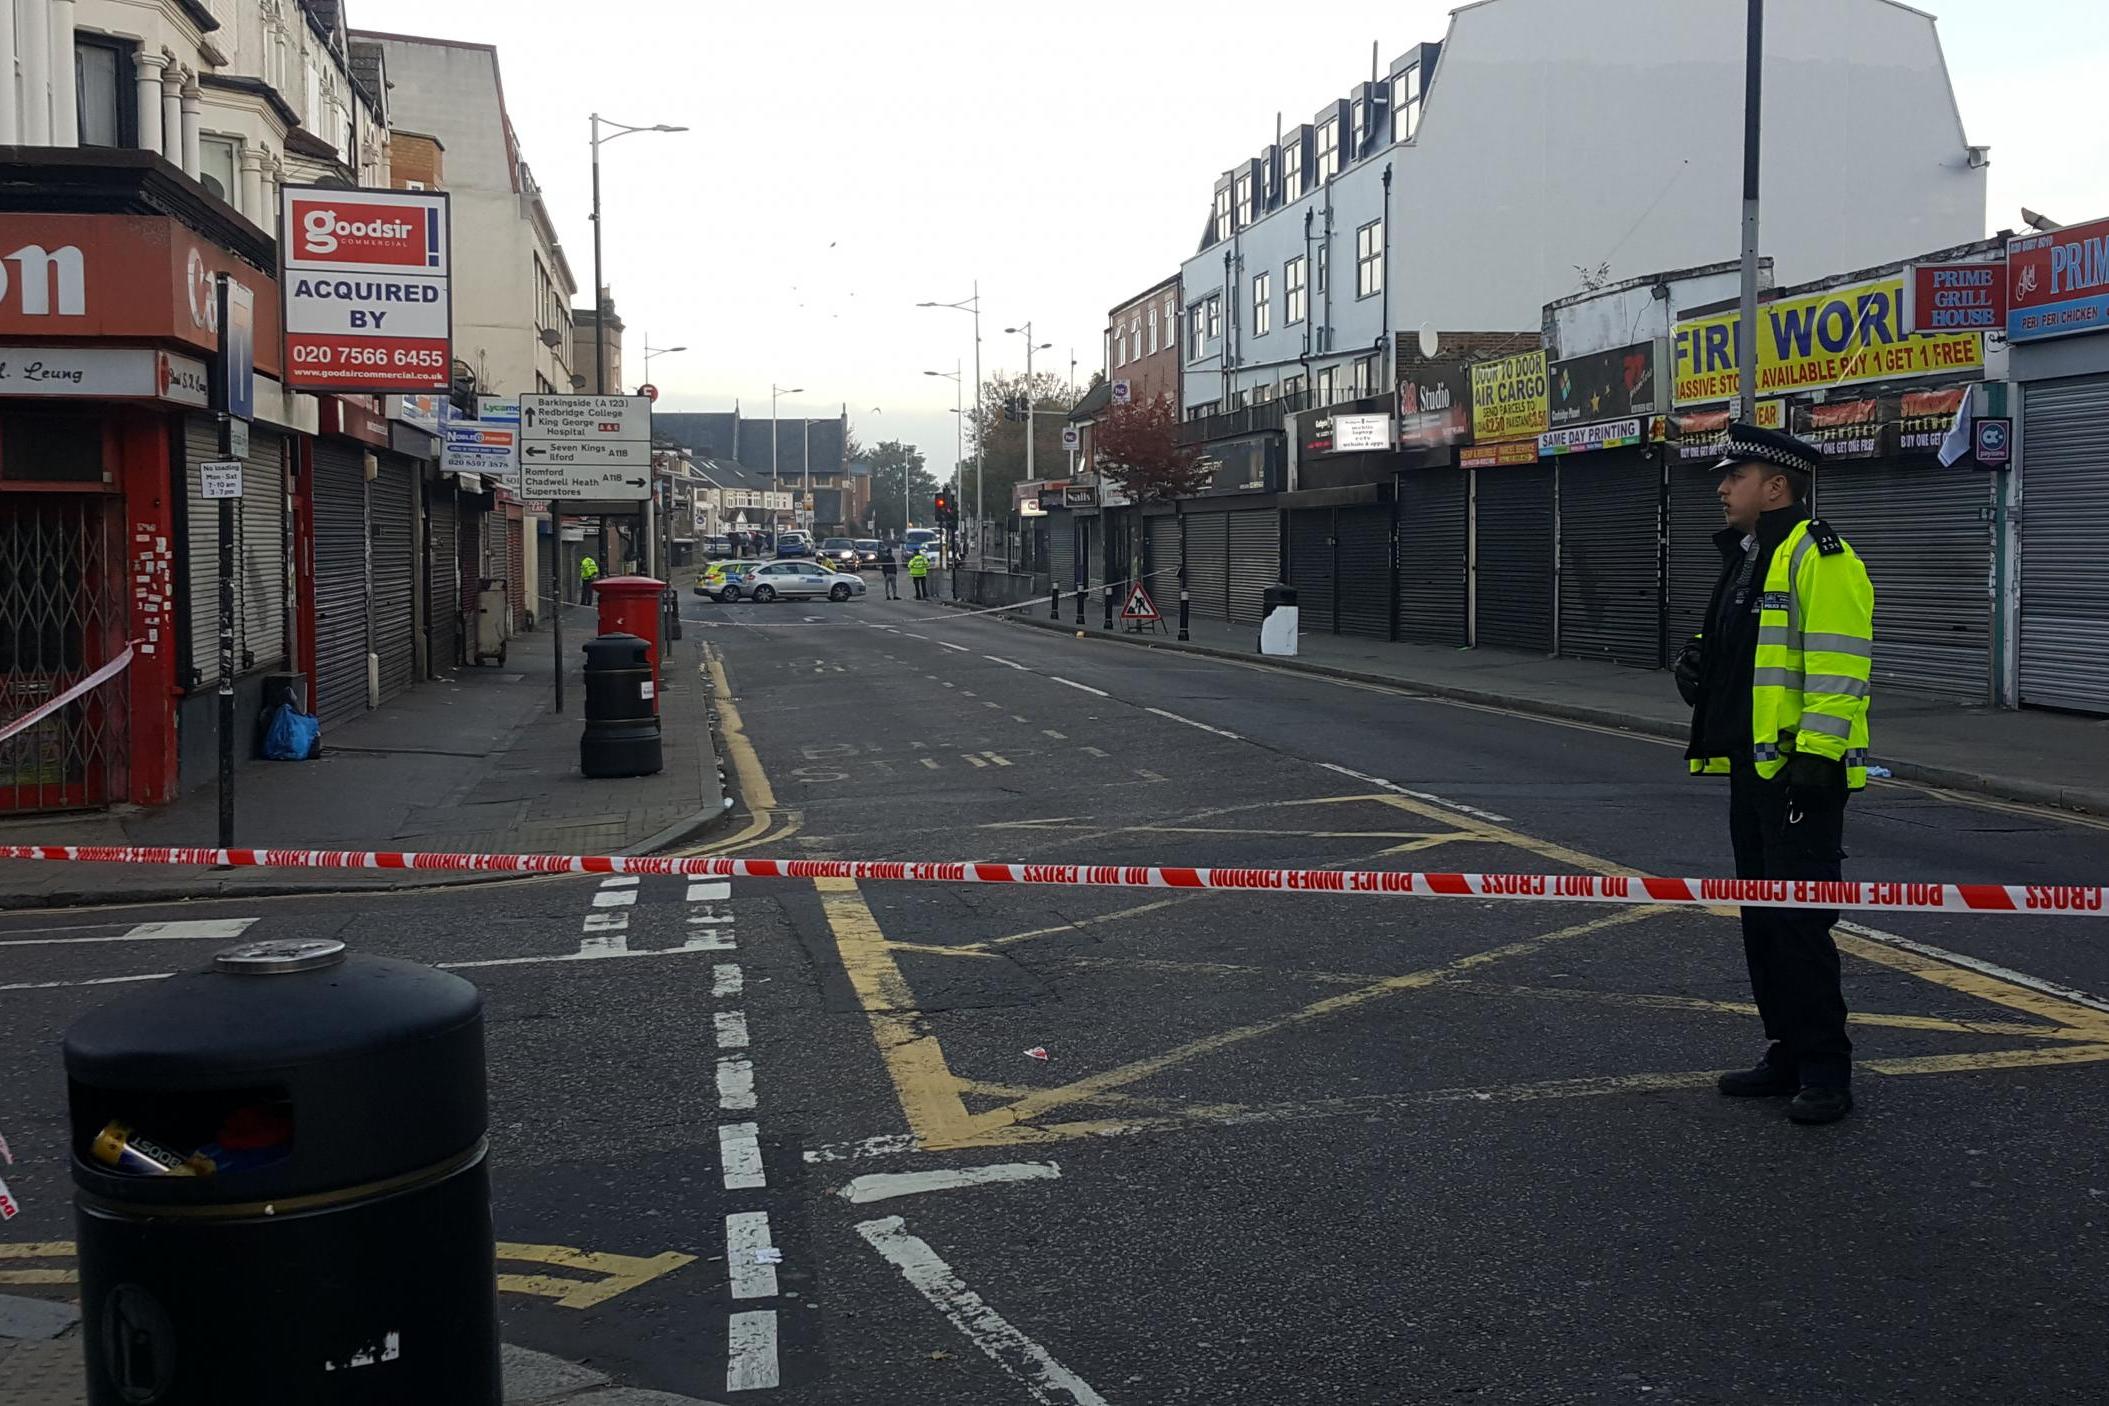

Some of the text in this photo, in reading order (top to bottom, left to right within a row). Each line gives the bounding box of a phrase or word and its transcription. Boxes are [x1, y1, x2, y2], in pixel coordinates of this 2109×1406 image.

[303, 210, 413, 254] goodsir
[340, 238, 408, 248] COMMERCIAL
[1932, 270, 1993, 289] PRIME
[294, 280, 439, 303] ACQUIRED
[1934, 290, 1992, 308] GRILL
[350, 310, 387, 329] BY
[1931, 308, 1996, 327] HOUSE
[2022, 307, 2098, 329] PERI PERI CHICKEN
[293, 346, 443, 366] 020 7566 6455
[1516, 354, 1543, 377] DOOR
[24, 361, 83, 383] Leung
[294, 368, 443, 381] www.goodsircommercial.co.uk
[1676, 378, 1717, 400] ASSIVE
[1762, 357, 1836, 388] AVAILABLE
[1873, 352, 1882, 373] 1
[1885, 346, 1914, 370] GET
[1919, 344, 1928, 367] 1
[1419, 382, 1450, 412] Studio
[1475, 376, 1545, 407] AIR CARGO
[538, 398, 591, 408] Barkingside
[538, 408, 623, 419] Redbridge College
[538, 418, 594, 428] King George
[547, 428, 585, 436] Hospital
[1542, 432, 1566, 448] SAME
[1568, 428, 1586, 444] DAY
[1588, 421, 1635, 442] PRINTING
[1901, 434, 1915, 448] BUY
[1916, 433, 1929, 447] ONE
[550, 443, 606, 453] Seven Kings
[550, 453, 574, 461] Ilford
[608, 449, 628, 457] A118
[525, 468, 564, 476] Romford
[525, 477, 599, 486] Chadwell Heath
[602, 473, 622, 482] A118
[525, 487, 581, 497] Superstores
[787, 860, 966, 881] POLICE INNER CORDON
[1023, 865, 1149, 885] DO NOT CROSS
[1209, 868, 1413, 892] POLICE INNER CORDON
[1481, 873, 1628, 898] DO NOT CROSS
[1700, 878, 1944, 907] POLICE INNER CORDON
[2025, 884, 2102, 911] CROSS
[129, 1137, 183, 1169] BOOST
